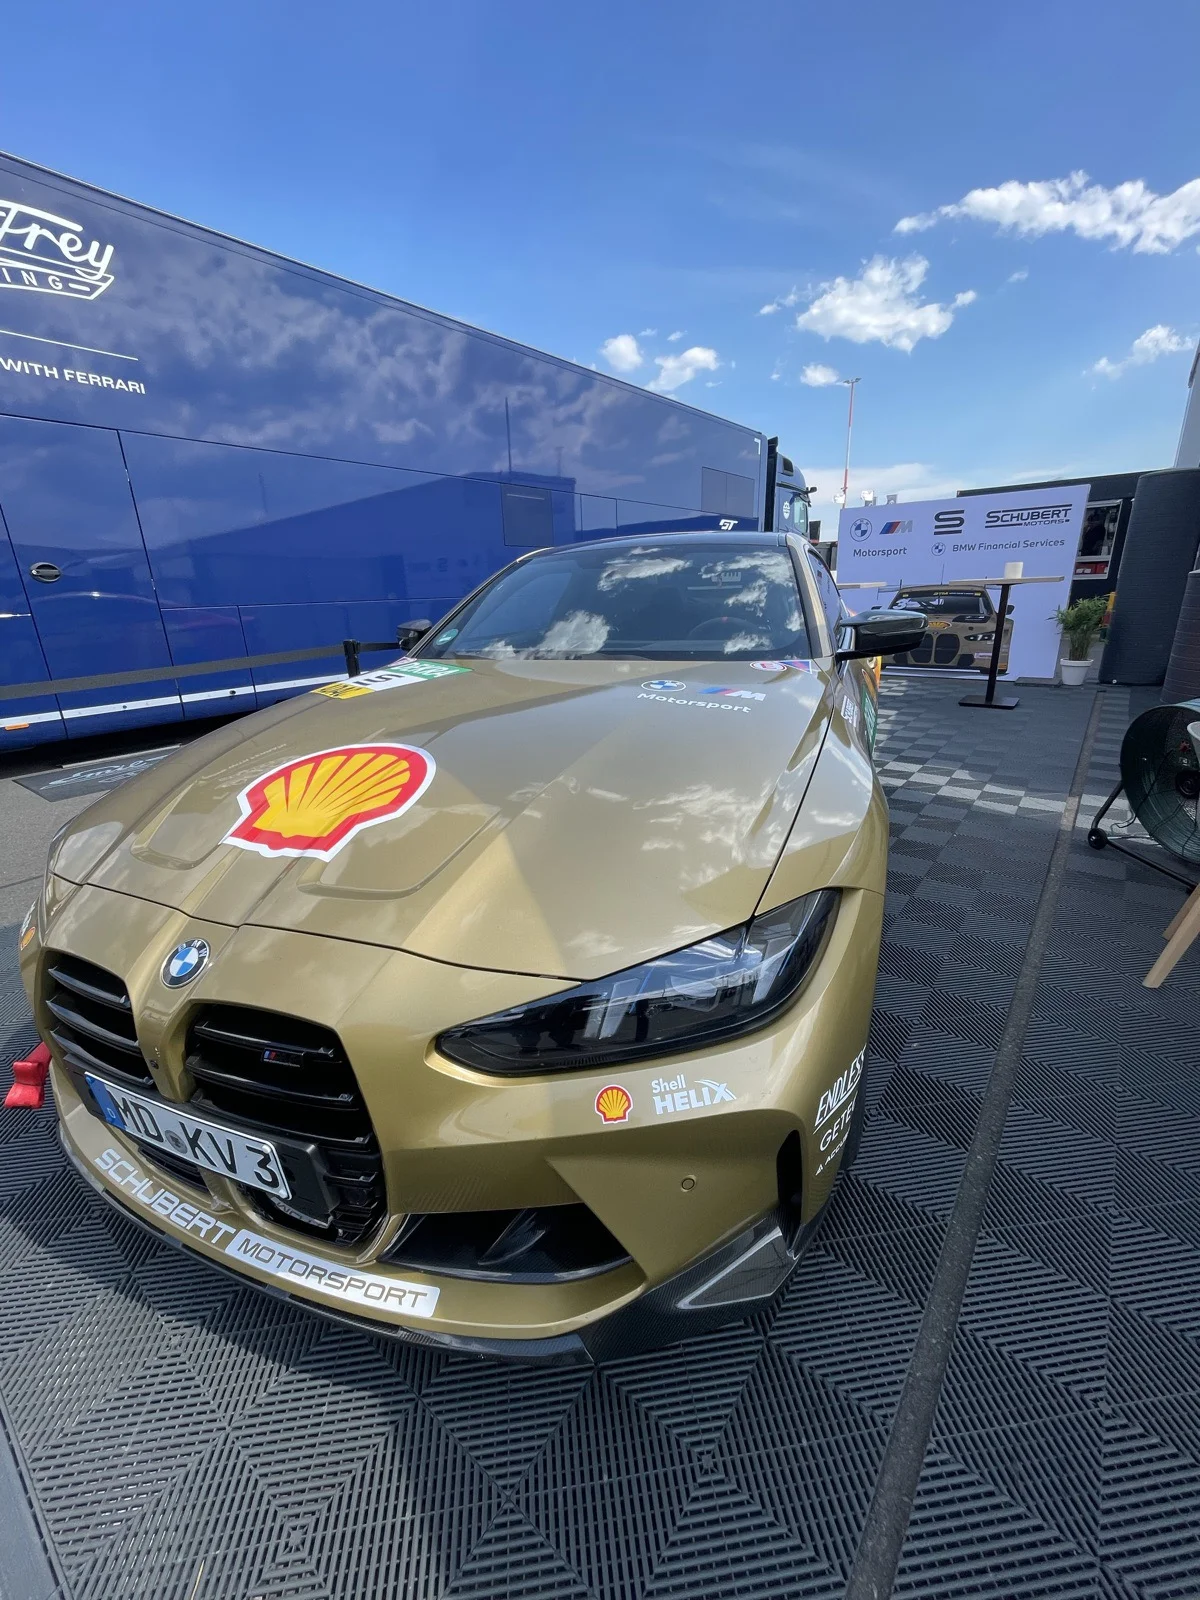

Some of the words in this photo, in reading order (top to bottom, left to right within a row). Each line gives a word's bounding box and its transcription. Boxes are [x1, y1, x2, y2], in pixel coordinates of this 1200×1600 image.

[0, 357, 59, 379] WITH
[63, 368, 146, 394] FERRARI
[985, 506, 1072, 525] SCHUBERT
[852, 546, 908, 558] Motorsport
[952, 543, 977, 553] BMW
[978, 539, 1021, 551] Financial
[1022, 538, 1065, 549] Services
[637, 692, 752, 714] Motorsport
[177, 938, 208, 958] BMW
[651, 1073, 686, 1094] Shell
[652, 1079, 737, 1115] HELIX
[108, 1089, 164, 1143] MD
[179, 1121, 238, 1175] KV
[246, 1144, 281, 1189] 3
[94, 1148, 236, 1244] SCHUBERT
[238, 1238, 428, 1309] MOTORSPORT
